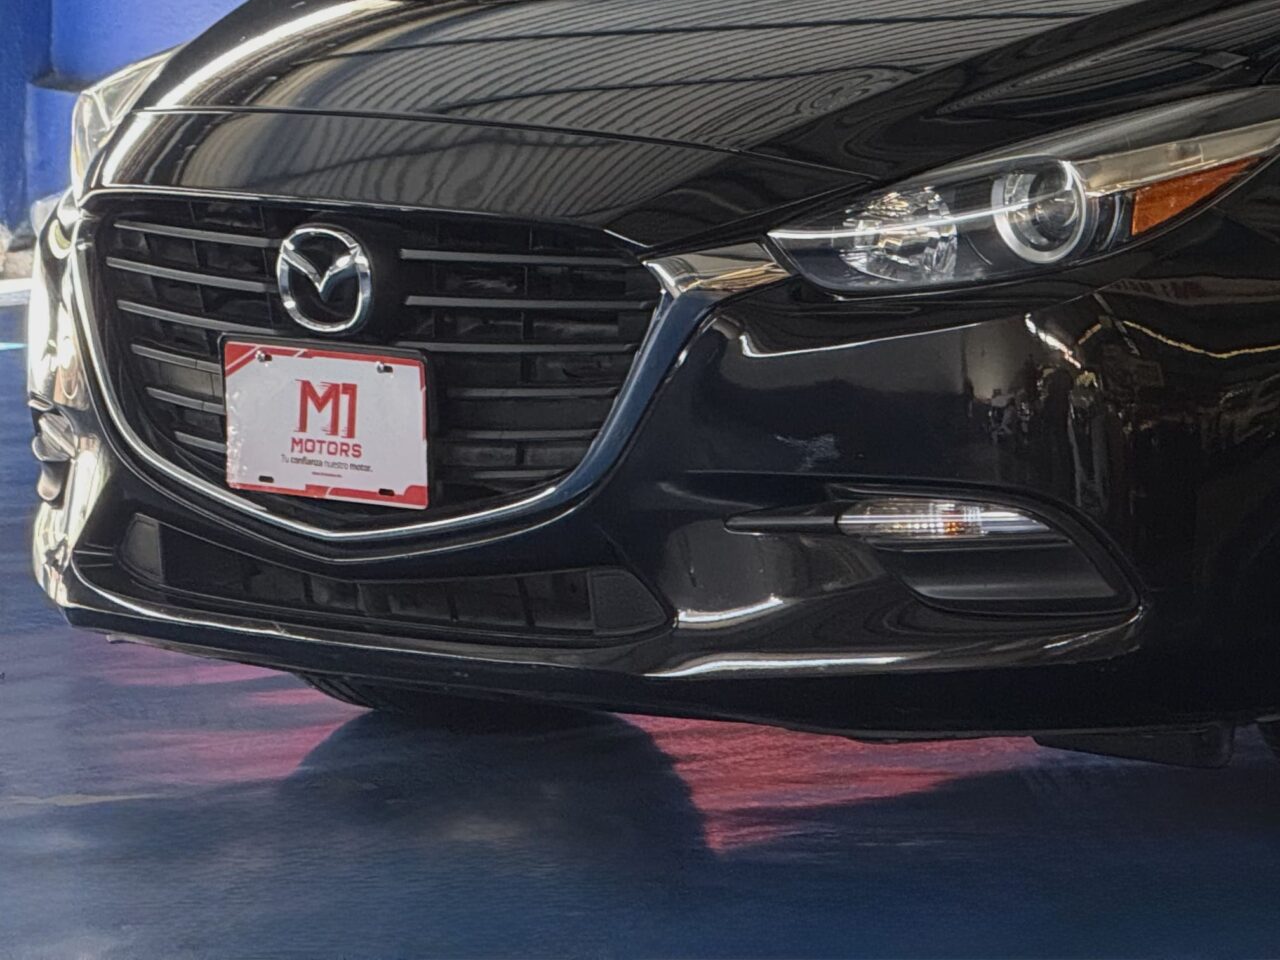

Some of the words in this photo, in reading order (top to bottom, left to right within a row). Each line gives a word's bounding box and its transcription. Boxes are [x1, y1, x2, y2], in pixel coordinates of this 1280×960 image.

[295, 379, 357, 438] M1
[291, 438, 362, 458] MOTORS
[290, 457, 323, 467] confianza
